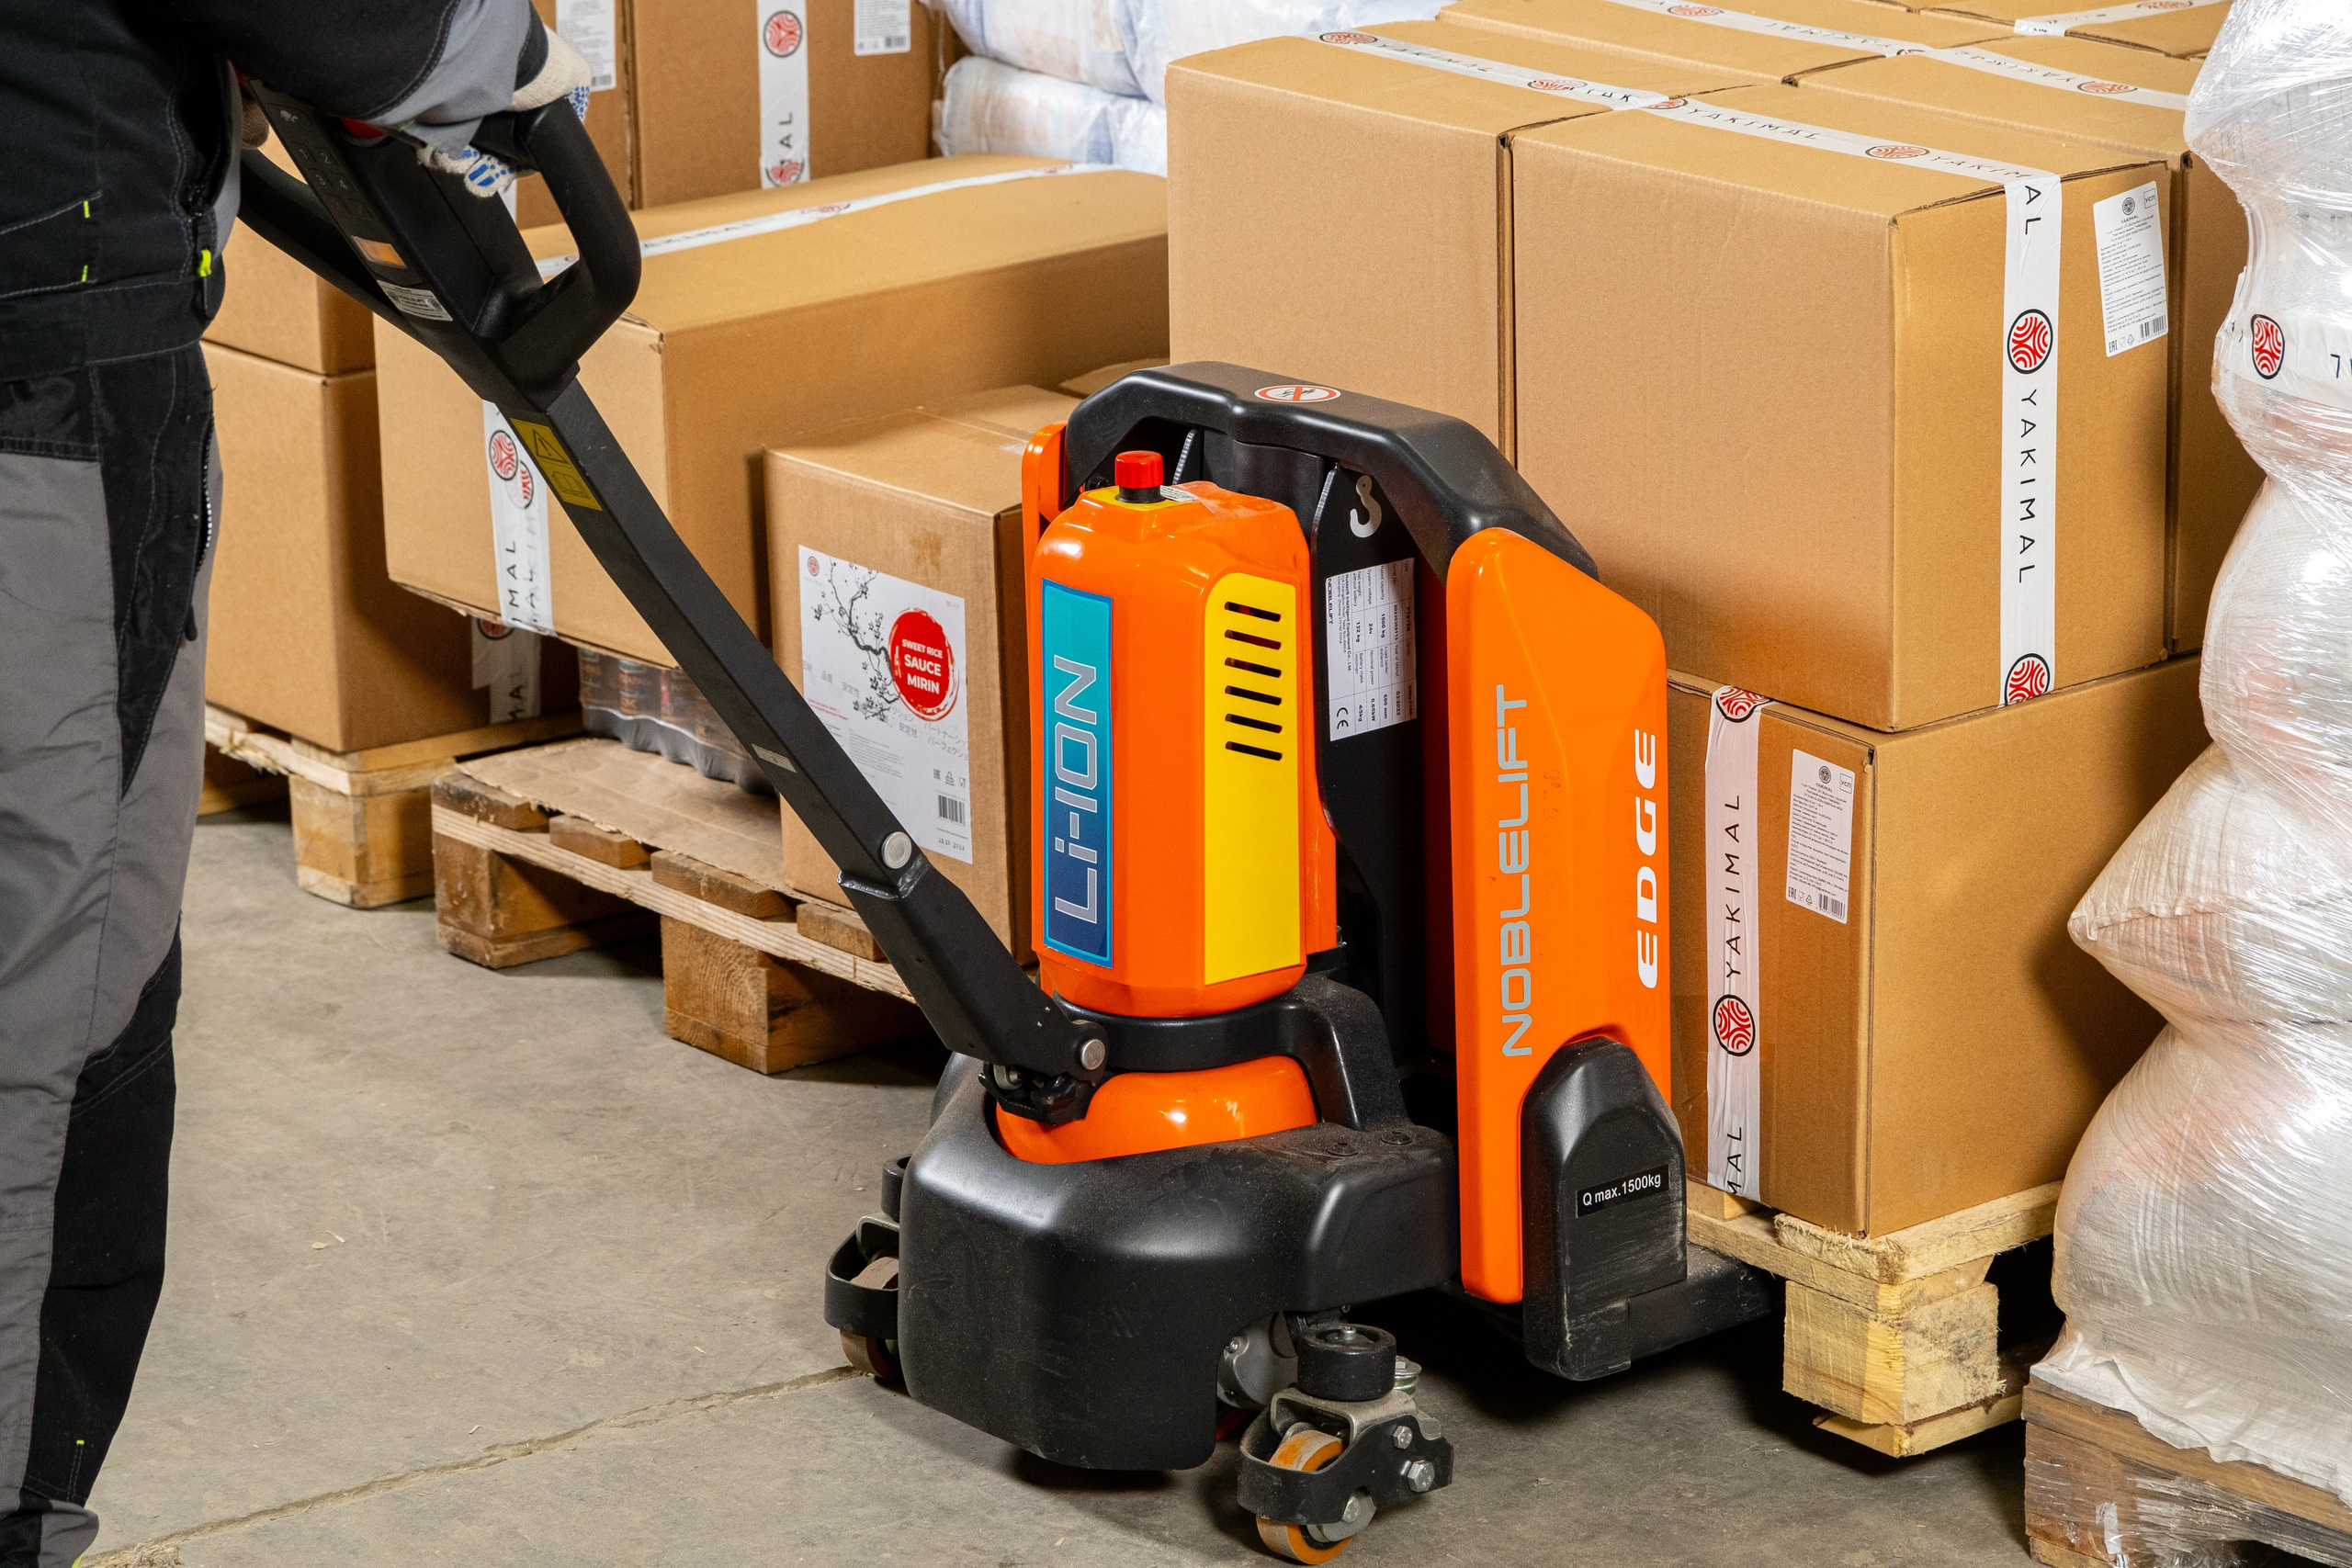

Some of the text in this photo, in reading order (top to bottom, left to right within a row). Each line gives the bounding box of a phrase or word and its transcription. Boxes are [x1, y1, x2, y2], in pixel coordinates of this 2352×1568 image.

[1688, 107, 1820, 140] YAKIMAL
[2019, 389, 2037, 583] YAKIMAL
[902, 638, 943, 659] SWEET RICE
[904, 654, 942, 677] SAUCE
[907, 672, 940, 694] MIRIN
[1054, 655, 1097, 924] Li-ION
[1497, 684, 1532, 1056] NOBLELIFT
[1634, 728, 1657, 989] EDGE
[1724, 795, 1740, 977] YAKIMAL
[1582, 1190, 1592, 1207] Q
